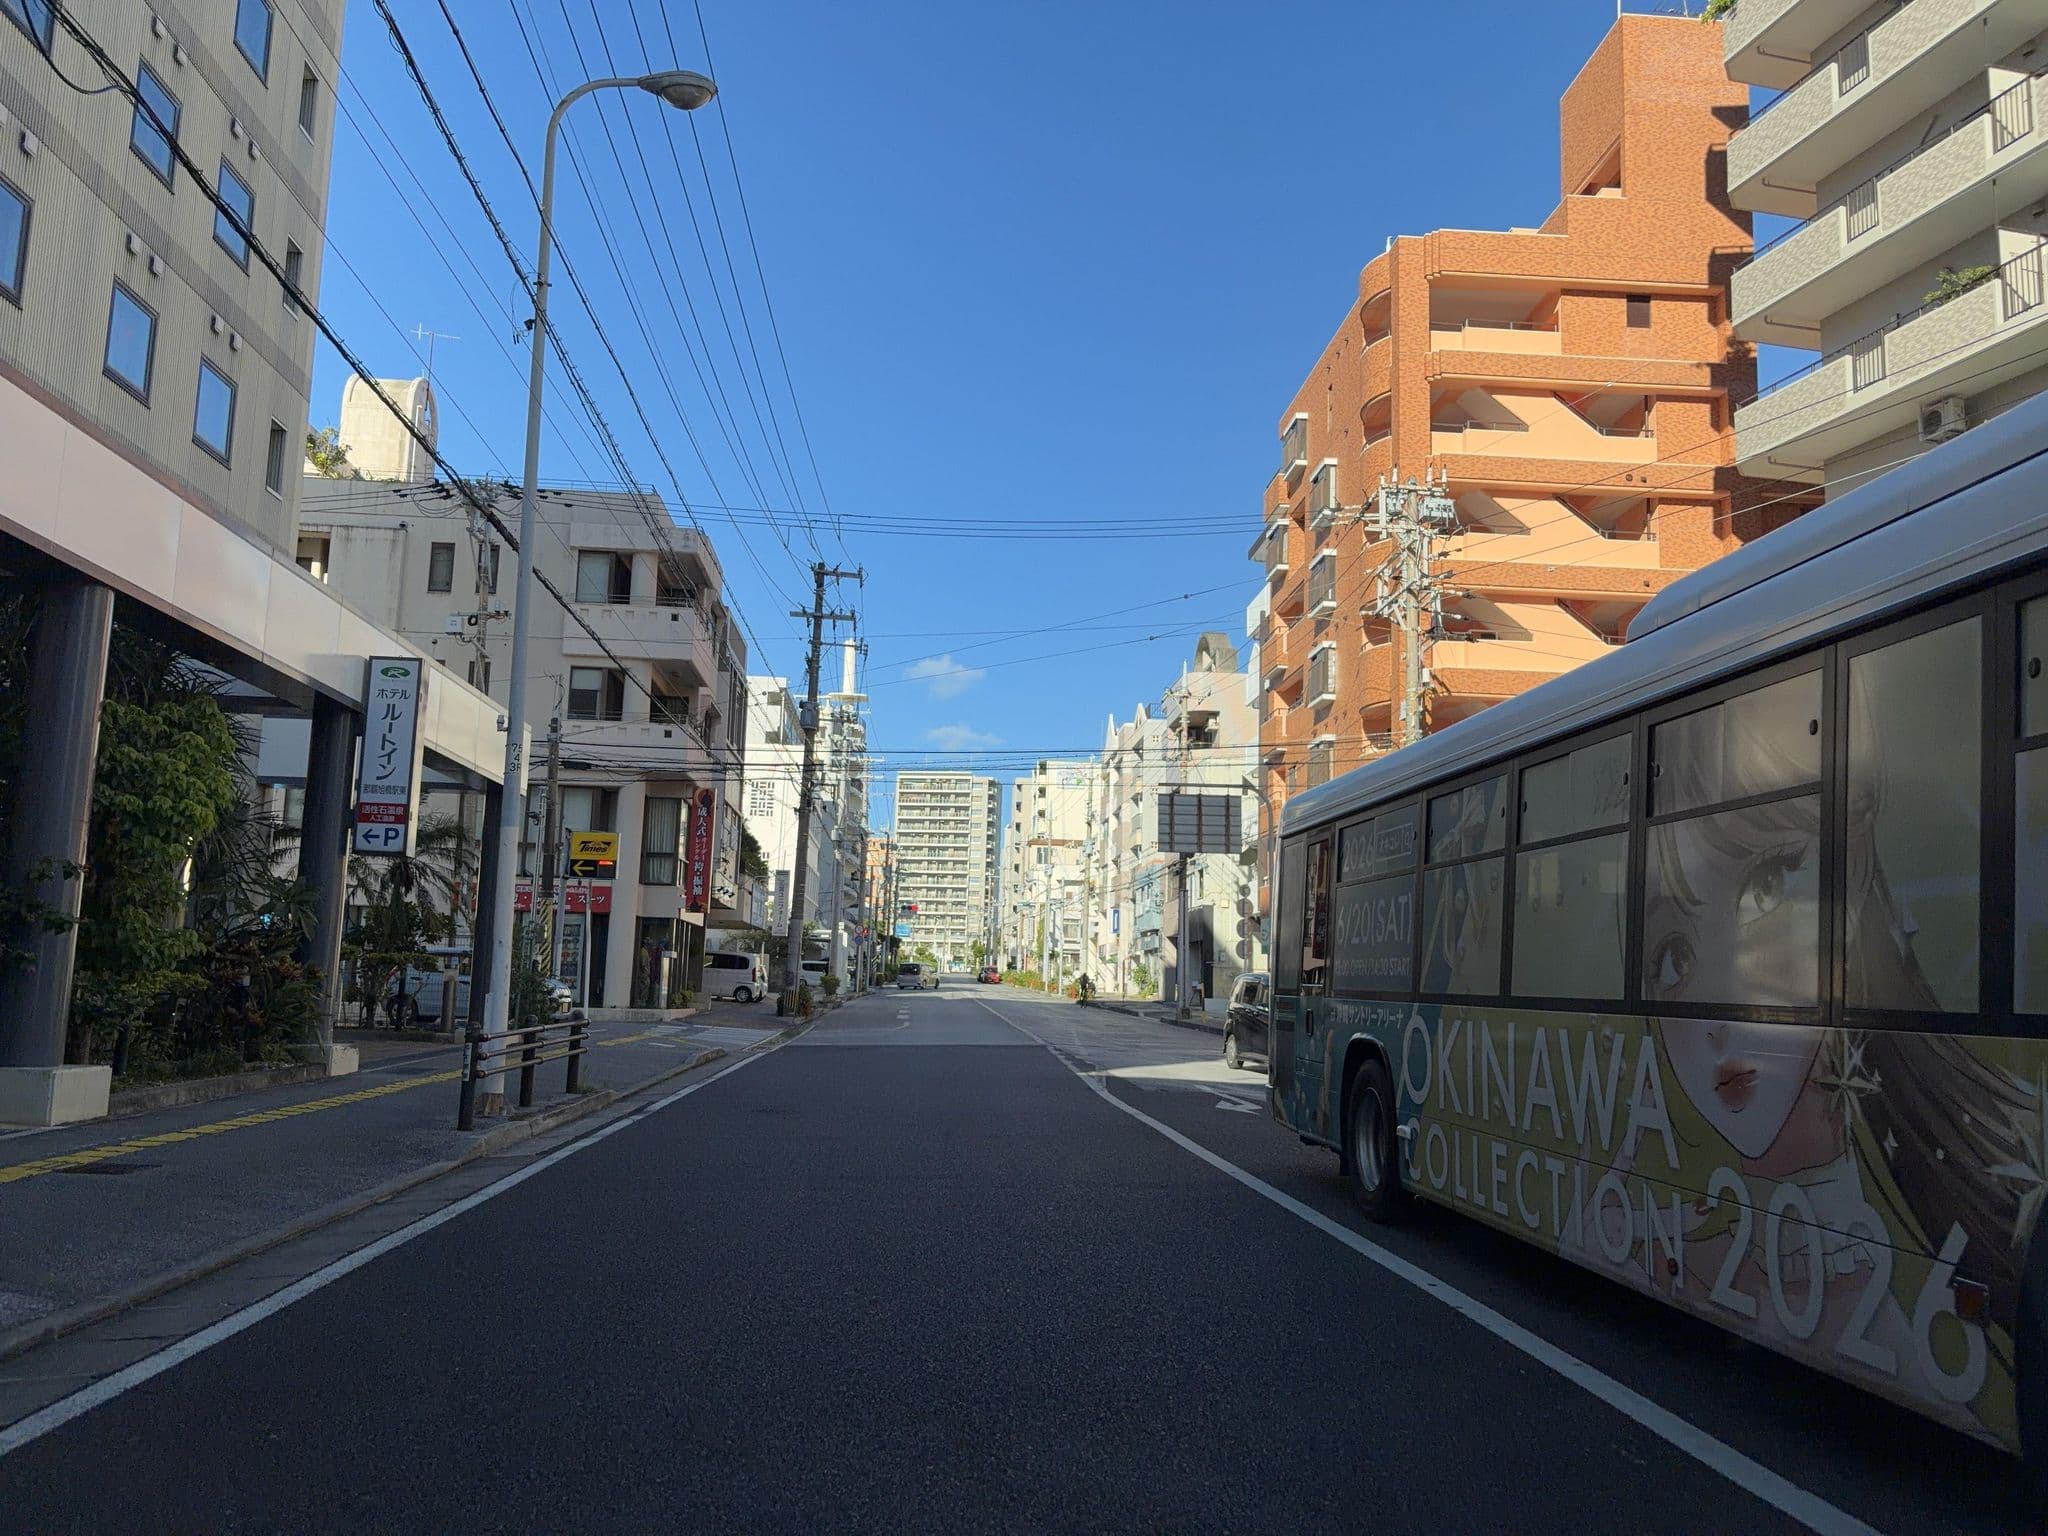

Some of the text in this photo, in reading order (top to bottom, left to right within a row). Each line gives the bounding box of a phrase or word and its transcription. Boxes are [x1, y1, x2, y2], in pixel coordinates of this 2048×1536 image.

[376, 688, 411, 700] ホテル
[376, 703, 403, 780] ルートイン
[514, 753, 520, 761] 4
[383, 827, 400, 846] P
[580, 840, 612, 853] Times
[1336, 893, 1413, 948] 6/20(SAT)
[1401, 1014, 1680, 1170] OKINAWA
[1407, 1116, 1988, 1403] COLLECTION 2026
